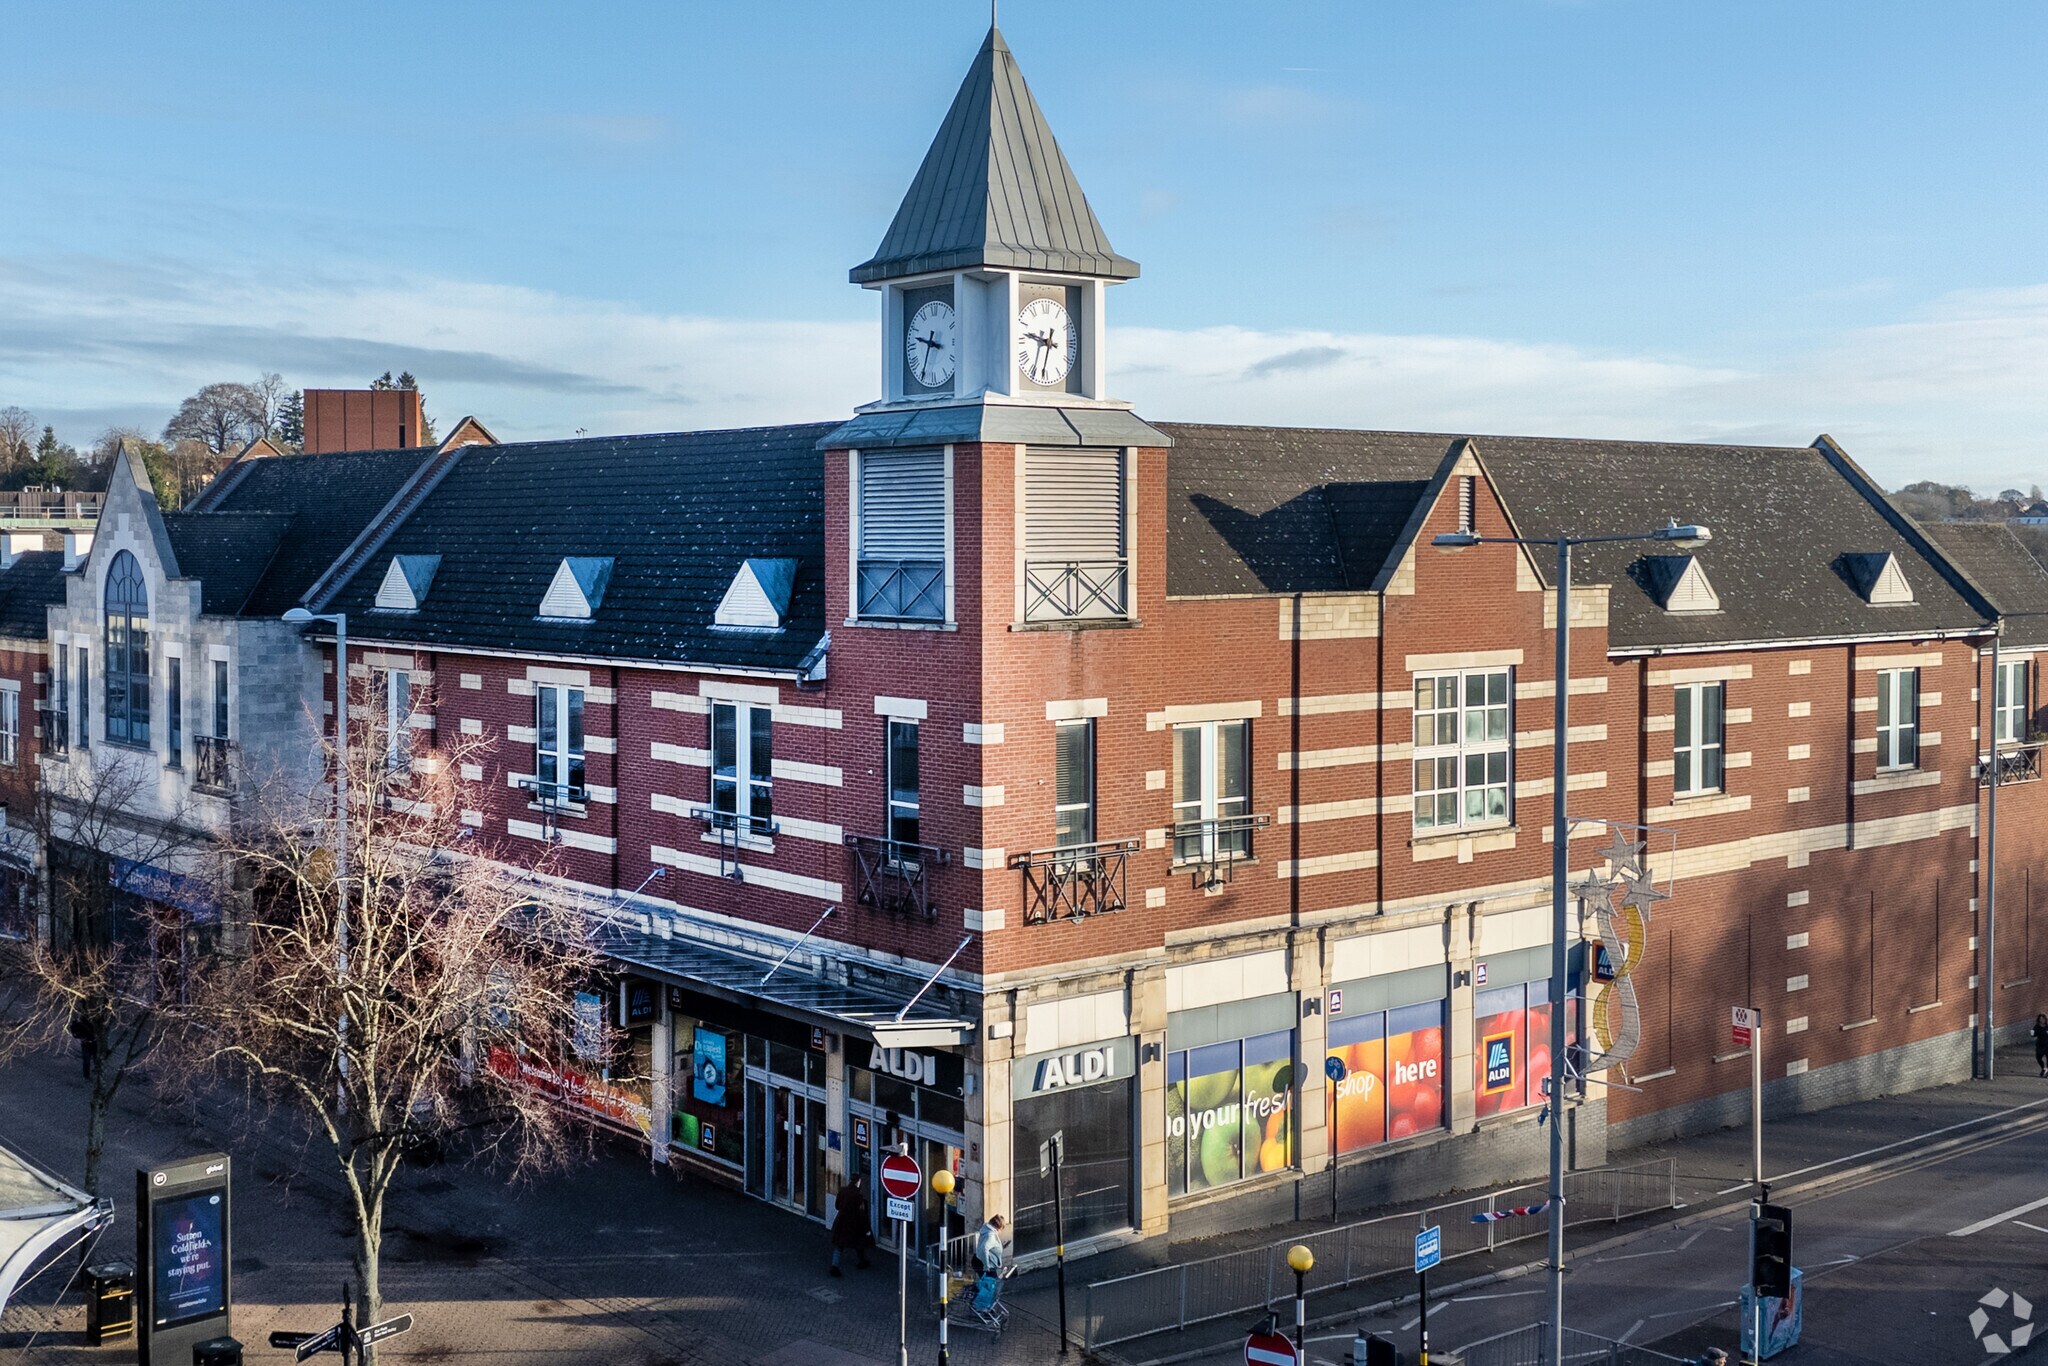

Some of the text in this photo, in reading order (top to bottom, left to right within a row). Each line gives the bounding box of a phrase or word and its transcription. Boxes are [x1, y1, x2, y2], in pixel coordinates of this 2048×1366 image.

[632, 1006, 652, 1016] ALDI
[868, 1044, 936, 1086] ALDI
[1041, 1046, 1115, 1091] ALDI
[1336, 1058, 1437, 1102] shop here
[1488, 1066, 1510, 1082] ALDI
[1190, 1102, 1240, 1140] your
[889, 1200, 911, 1212] Except
[890, 1208, 909, 1218] buses
[176, 1231, 202, 1243] Sutton
[167, 1265, 195, 1278] staying
